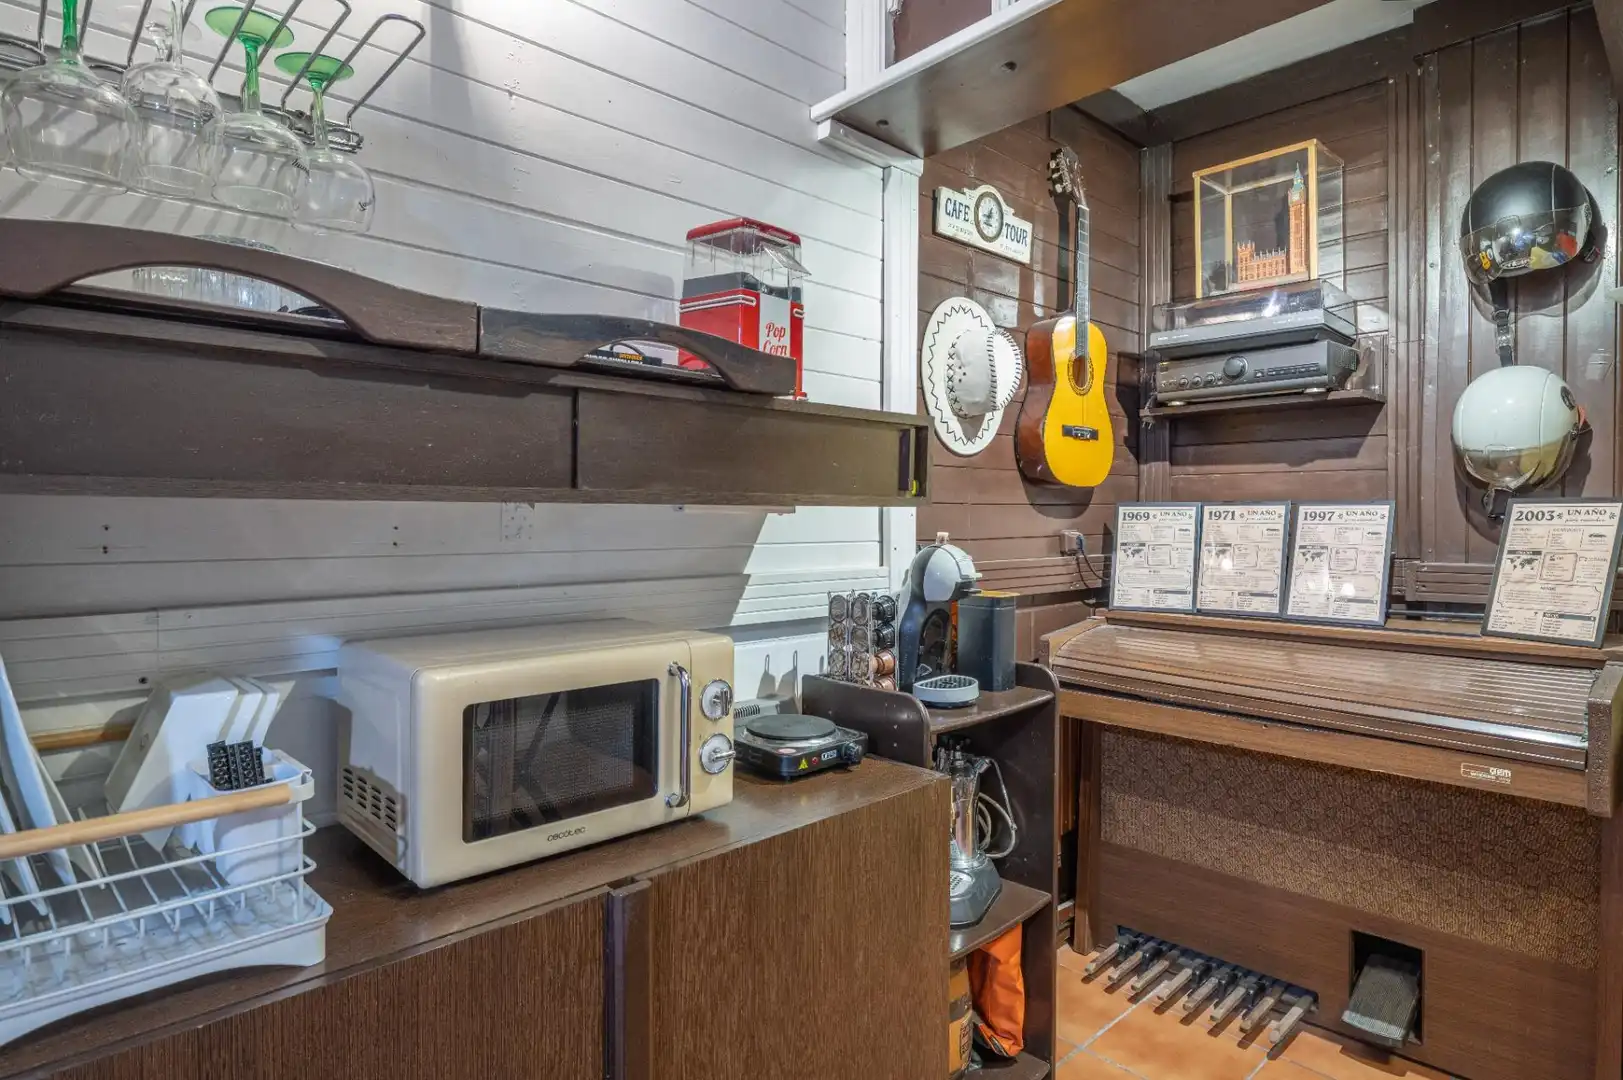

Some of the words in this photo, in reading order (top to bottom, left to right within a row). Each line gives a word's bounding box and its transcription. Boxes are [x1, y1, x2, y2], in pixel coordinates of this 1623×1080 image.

[945, 197, 970, 222] CAFE
[1004, 222, 1028, 247] TOUR
[766, 322, 786, 342] Pop
[763, 340, 787, 356] Corn
[1122, 511, 1150, 522] 1969
[1208, 510, 1236, 521] 1971
[1303, 511, 1335, 522] 1997
[1514, 510, 1556, 522] 2003
[1584, 508, 1607, 516] AÑO
[547, 826, 586, 842] cecotec
